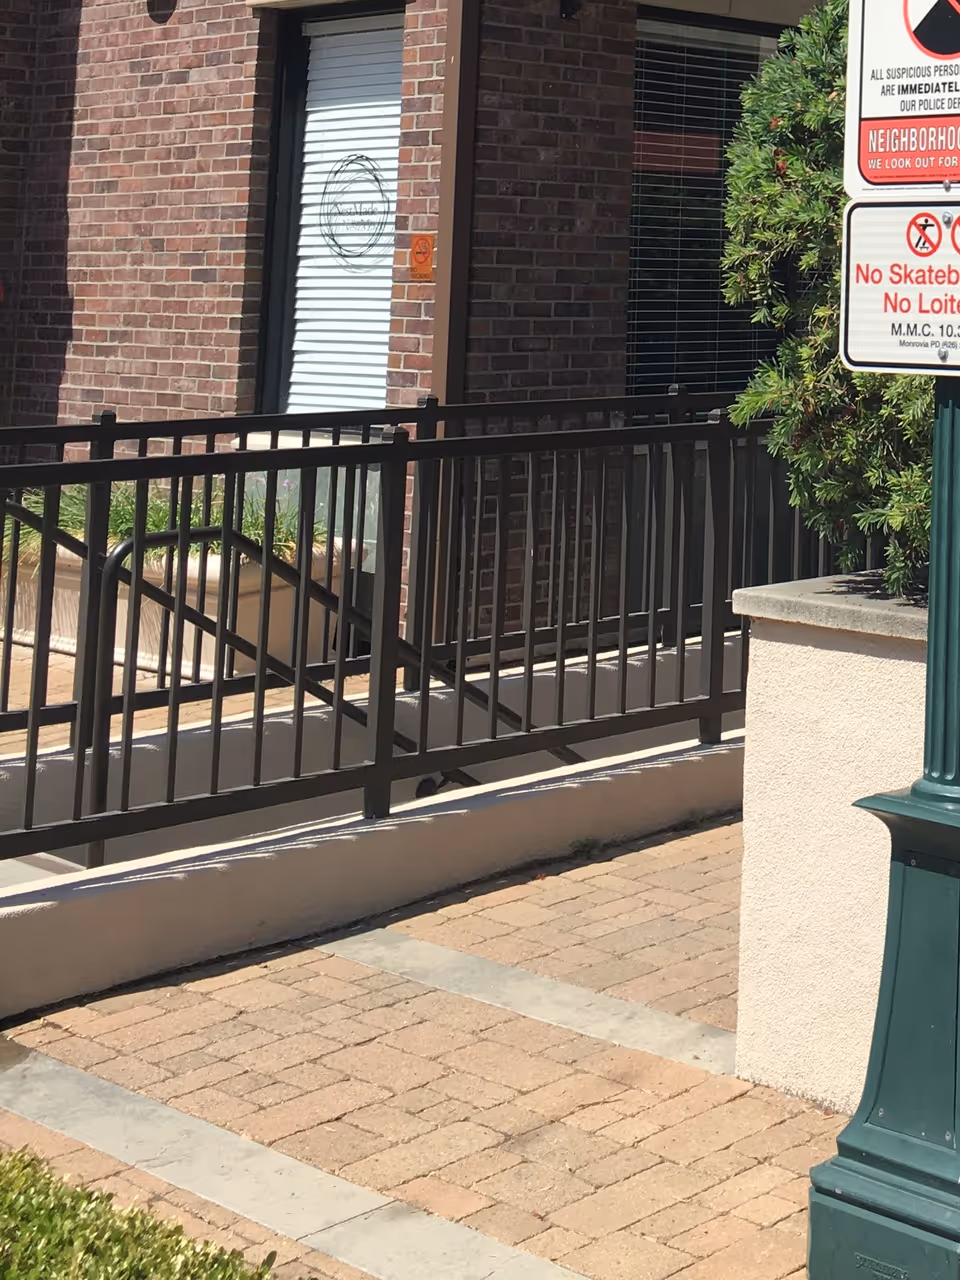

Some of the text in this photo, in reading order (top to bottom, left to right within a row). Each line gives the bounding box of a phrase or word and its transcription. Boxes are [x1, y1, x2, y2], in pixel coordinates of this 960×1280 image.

[870, 69, 884, 81] ALL
[886, 65, 932, 80] SUSPICIOUS
[880, 84, 896, 97] ARE
[900, 99, 916, 112] OUR
[918, 97, 945, 111] POLICE
[868, 158, 882, 169] WE
[885, 157, 912, 169] LOOK
[915, 157, 935, 168] OUT
[938, 156, 958, 168] FOR
[856, 263, 883, 285] No
[884, 292, 911, 314] No
[890, 322, 934, 337] M.M.C.
[899, 339, 929, 348] Monrovia
[930, 340, 940, 349] PD
